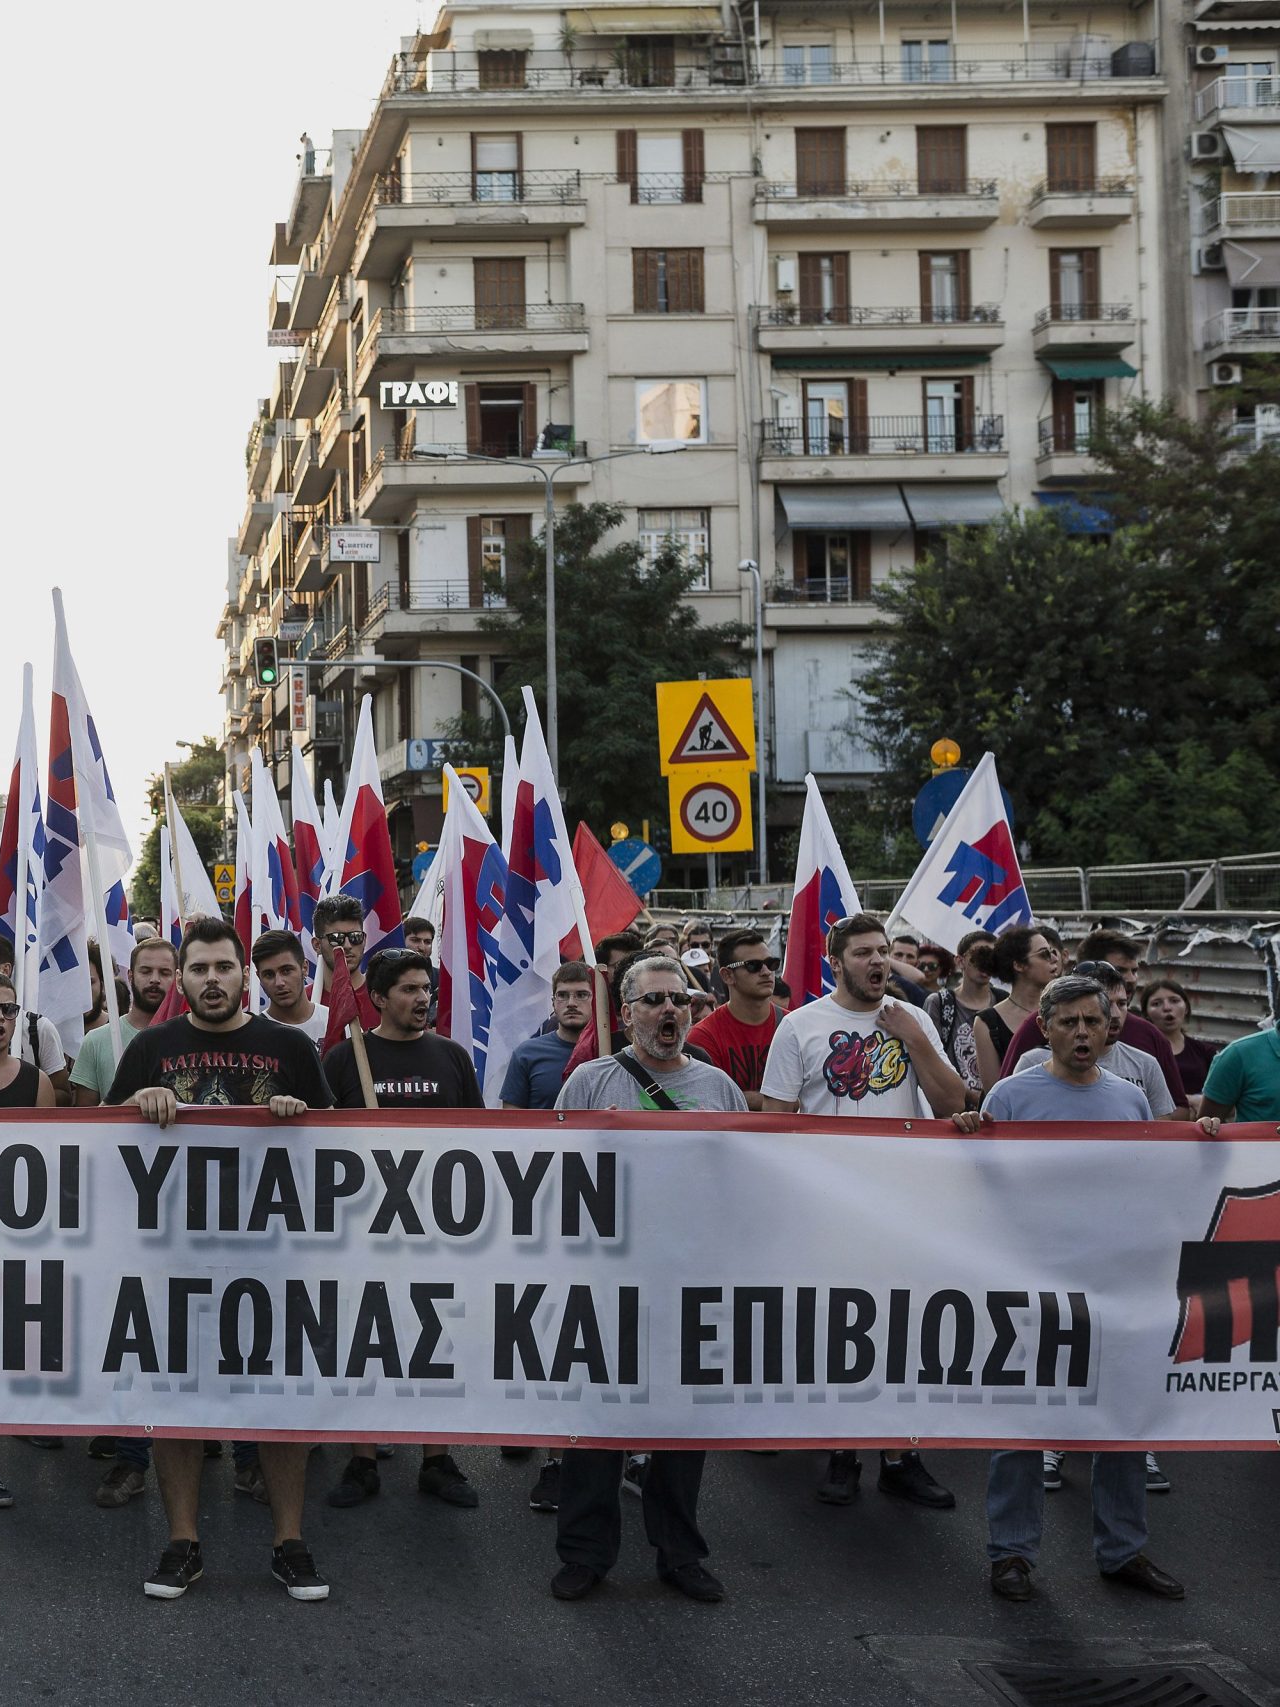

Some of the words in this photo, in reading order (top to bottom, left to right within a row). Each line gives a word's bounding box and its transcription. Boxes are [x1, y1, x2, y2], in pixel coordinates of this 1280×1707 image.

[694, 800, 728, 824] 40
[160, 1051, 279, 1073] KATAKLYSM
[117, 1144, 617, 1238] ΥΠΑΡΧΟΥΝ
[101, 1275, 456, 1379] ΑΓΩΝΑΣ
[493, 1282, 640, 1385] ΚΑΙ
[680, 1286, 1091, 1388] ΕΠΙΒΙΩΣΗ
[1166, 1371, 1280, 1393] ΠΑΝΕΡΓΑ
